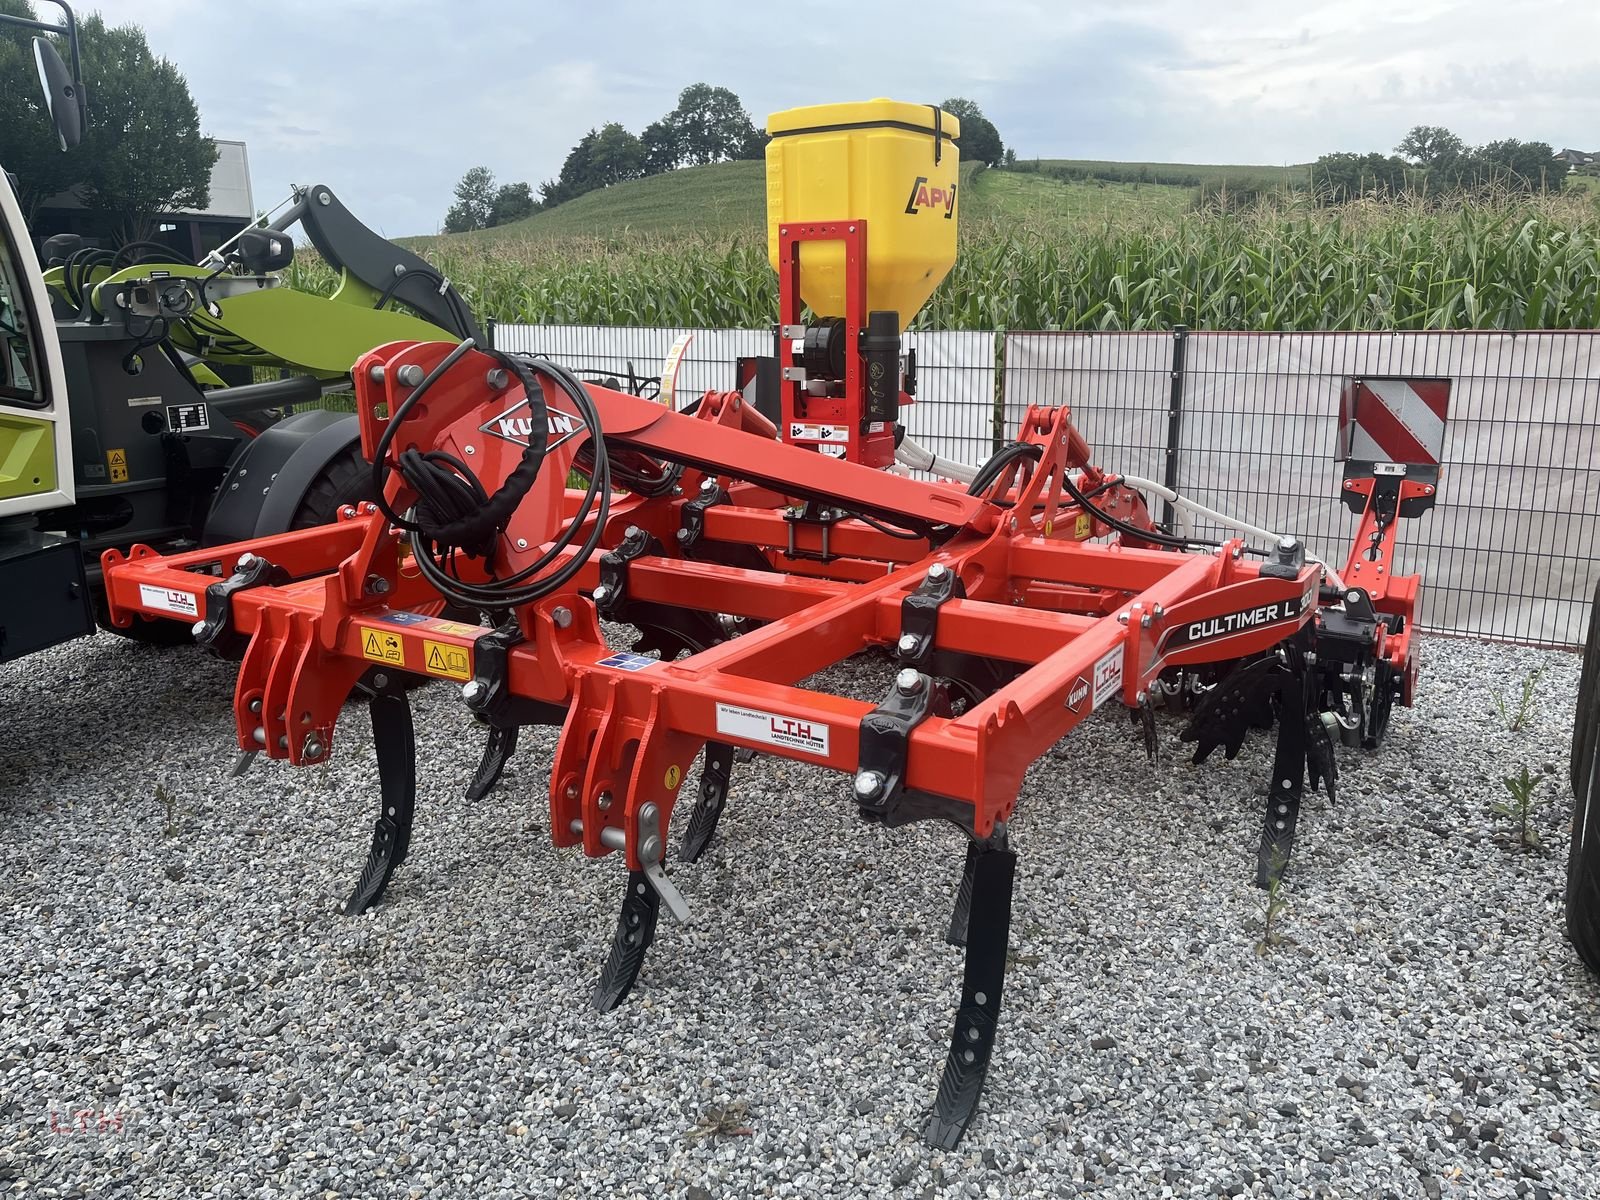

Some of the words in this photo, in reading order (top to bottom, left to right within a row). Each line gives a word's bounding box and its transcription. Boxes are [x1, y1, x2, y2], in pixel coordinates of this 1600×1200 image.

[1189, 604, 1278, 640] CULTIMER
[1284, 602, 1294, 616] L
[1069, 684, 1088, 707] KUHN
[771, 733, 805, 745] LANDTECHNIK
[806, 740, 825, 749] HÜTTER
